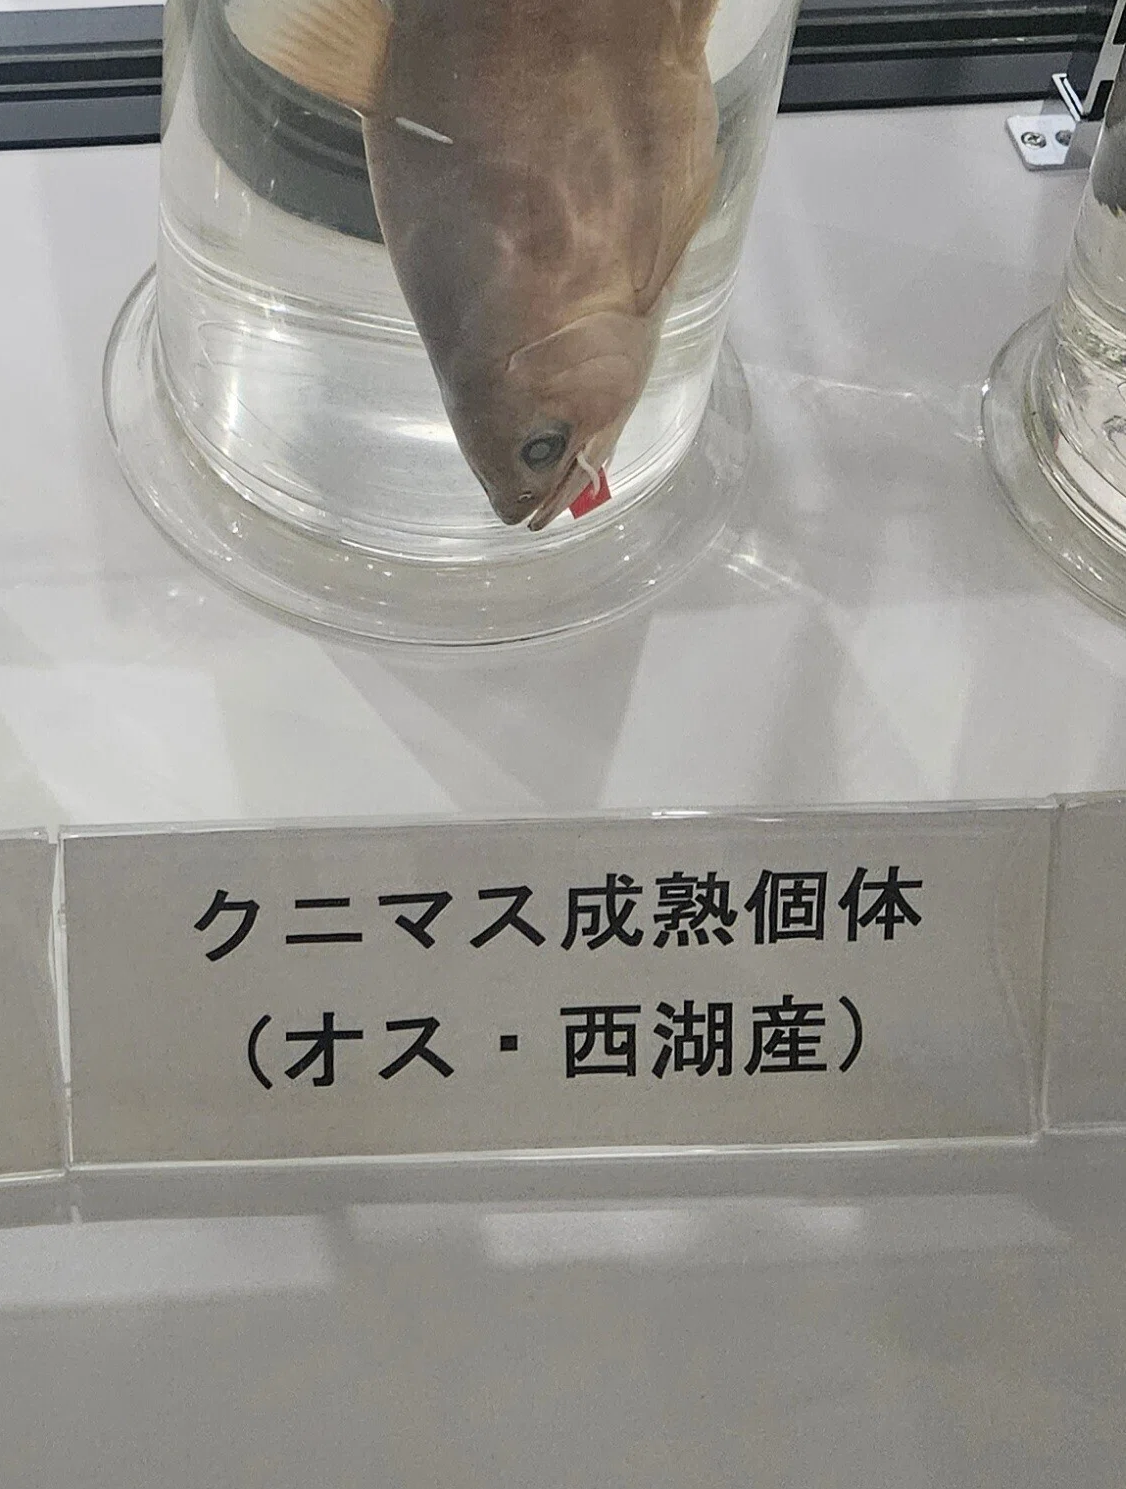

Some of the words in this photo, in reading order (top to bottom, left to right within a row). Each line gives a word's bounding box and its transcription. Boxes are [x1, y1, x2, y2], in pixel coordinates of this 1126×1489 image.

[193, 866, 924, 963] クニマス成熟個体
